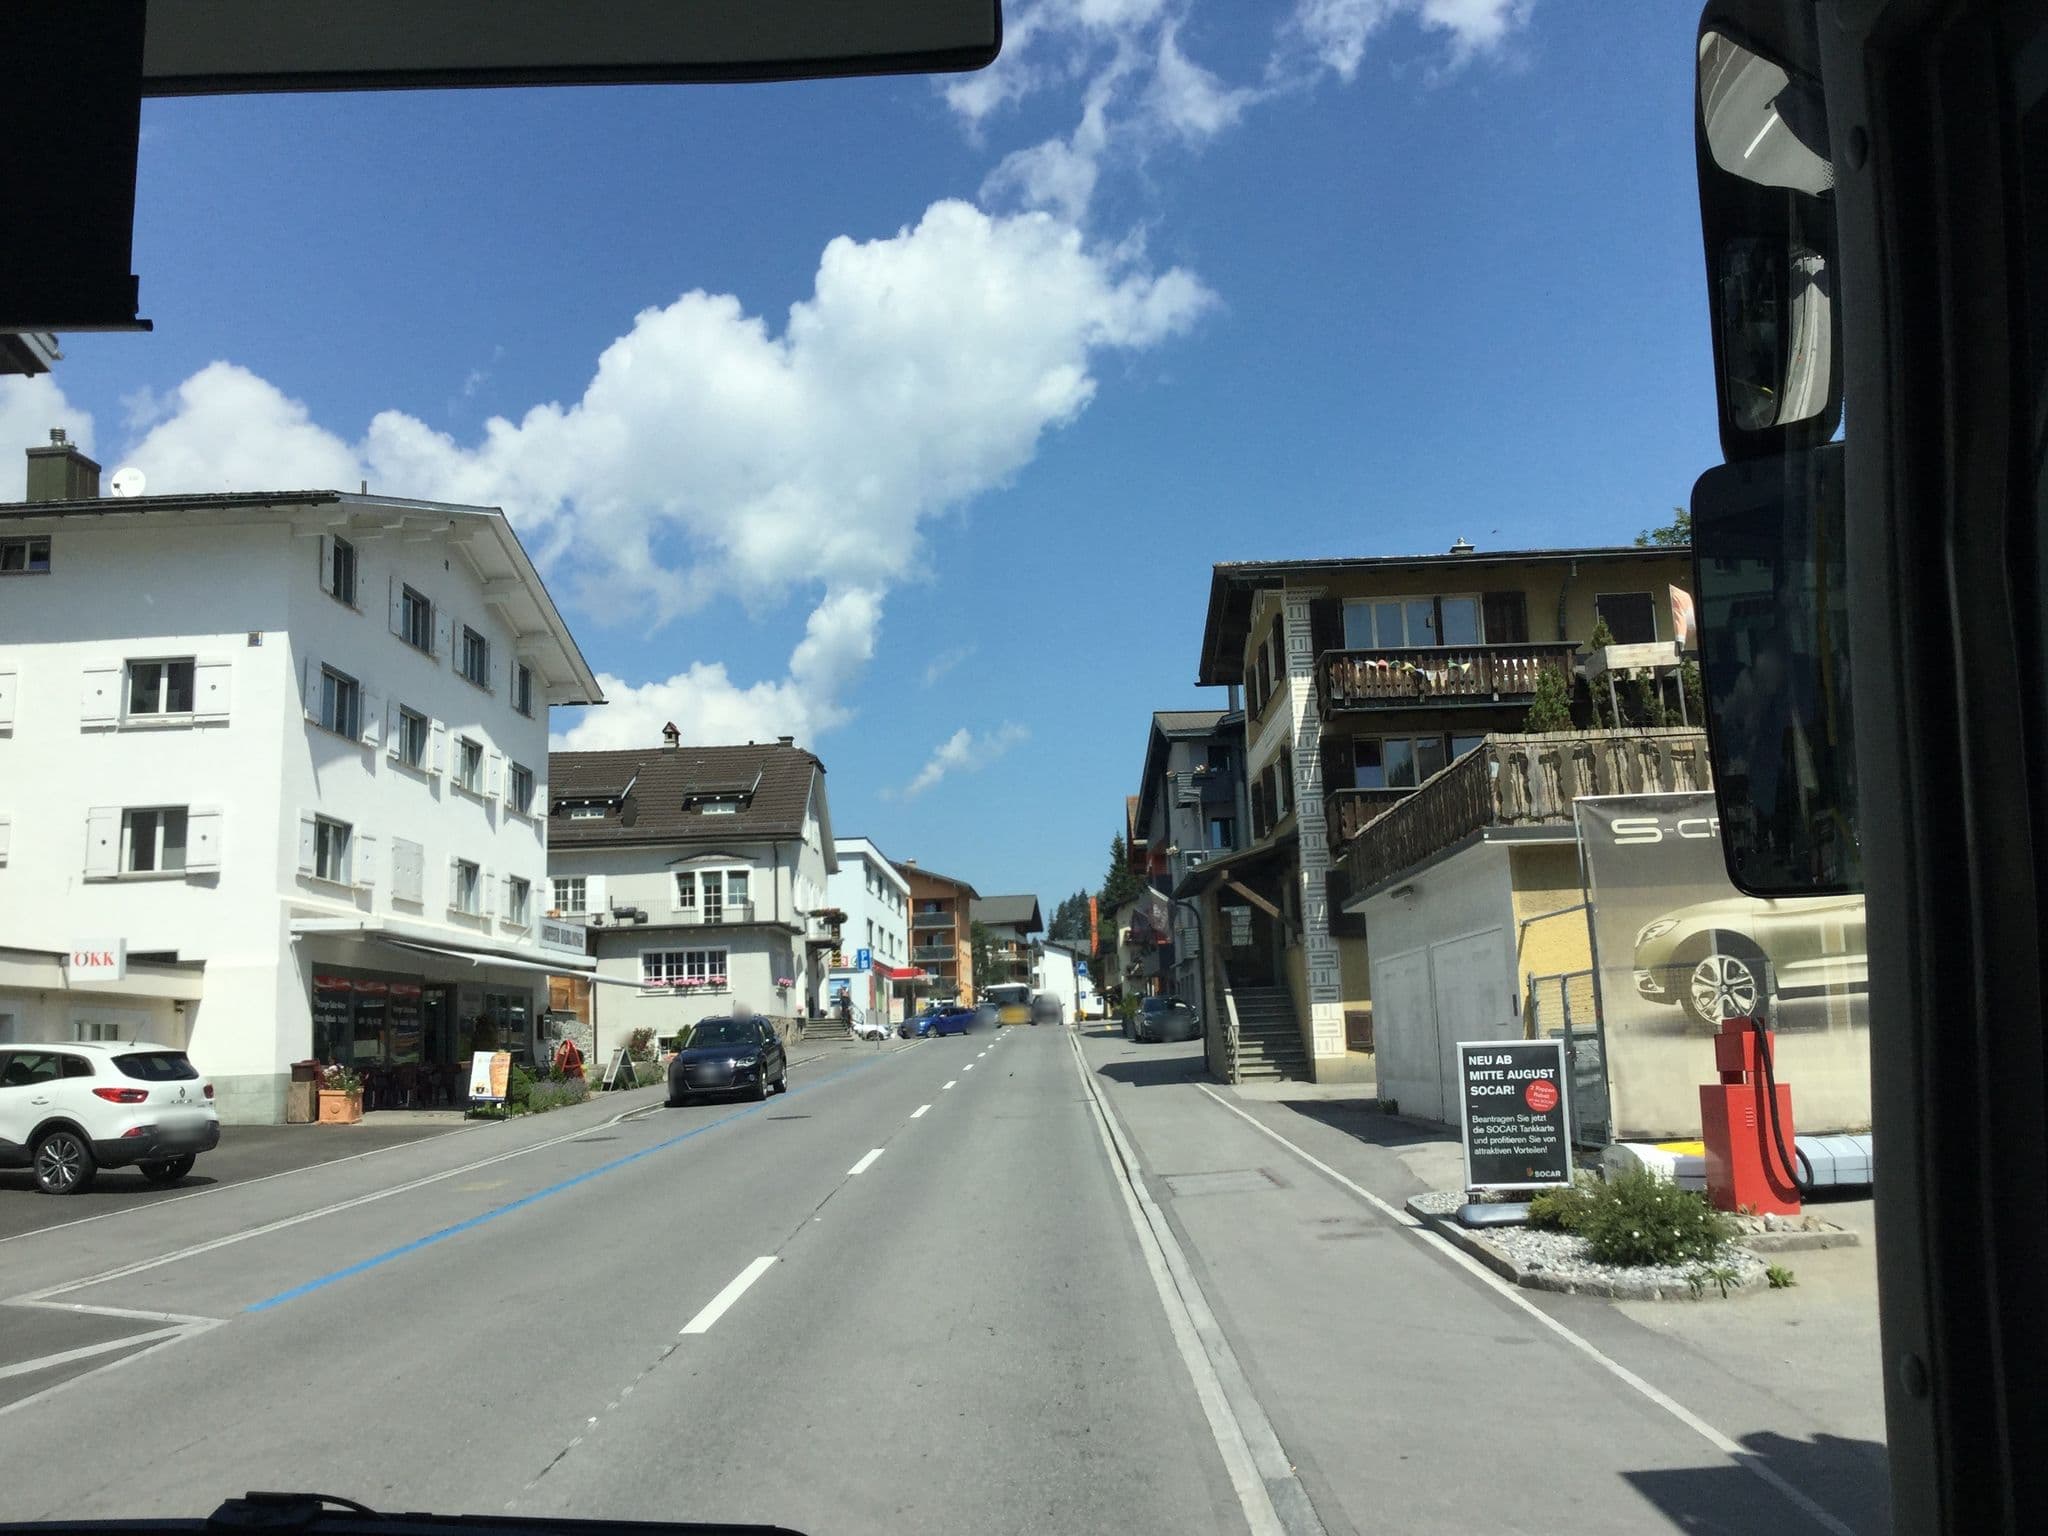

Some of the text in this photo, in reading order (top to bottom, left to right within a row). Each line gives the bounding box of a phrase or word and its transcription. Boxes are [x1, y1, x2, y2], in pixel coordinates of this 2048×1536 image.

[74, 951, 114, 967] ÖKK
[1469, 1055, 1512, 1065] NEU AB
[1470, 1069, 1554, 1080] MITTE AUGUST
[1470, 1085, 1515, 1095] SOCAR!
[1472, 1114, 1547, 1124] Beantragen Sie jetzt
[1472, 1124, 1555, 1134] die SOCAR Tankkarte
[1473, 1136, 1488, 1145] und
[1490, 1135, 1527, 1145] profitieren
[1528, 1134, 1542, 1143] Sie
[1474, 1146, 1548, 1155] attraktiven Vorteilen!
[1534, 1170, 1562, 1178] SOCAR
